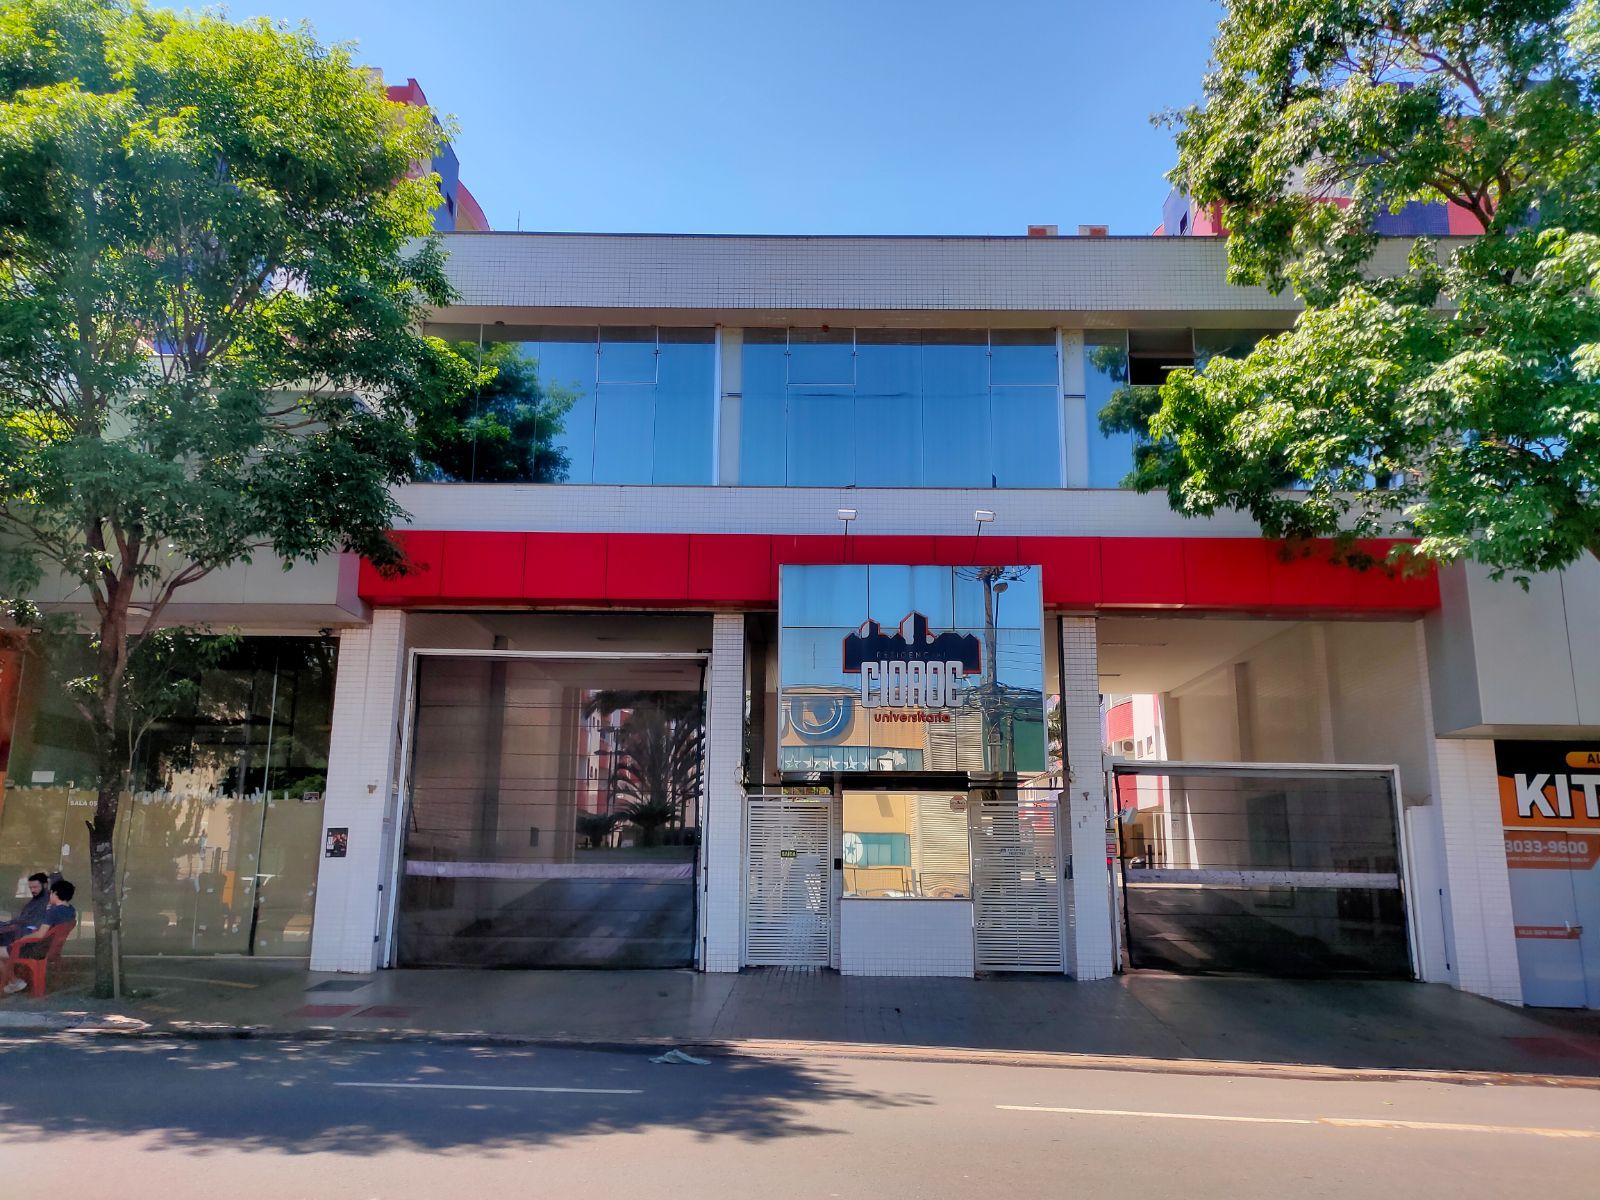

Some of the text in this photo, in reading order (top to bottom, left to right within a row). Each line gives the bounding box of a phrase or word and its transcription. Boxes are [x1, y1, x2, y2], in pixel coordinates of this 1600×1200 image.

[876, 651, 947, 659] RESIDENCAL
[1514, 773, 1600, 817] KIT
[1505, 840, 1588, 855] 3033-9600
